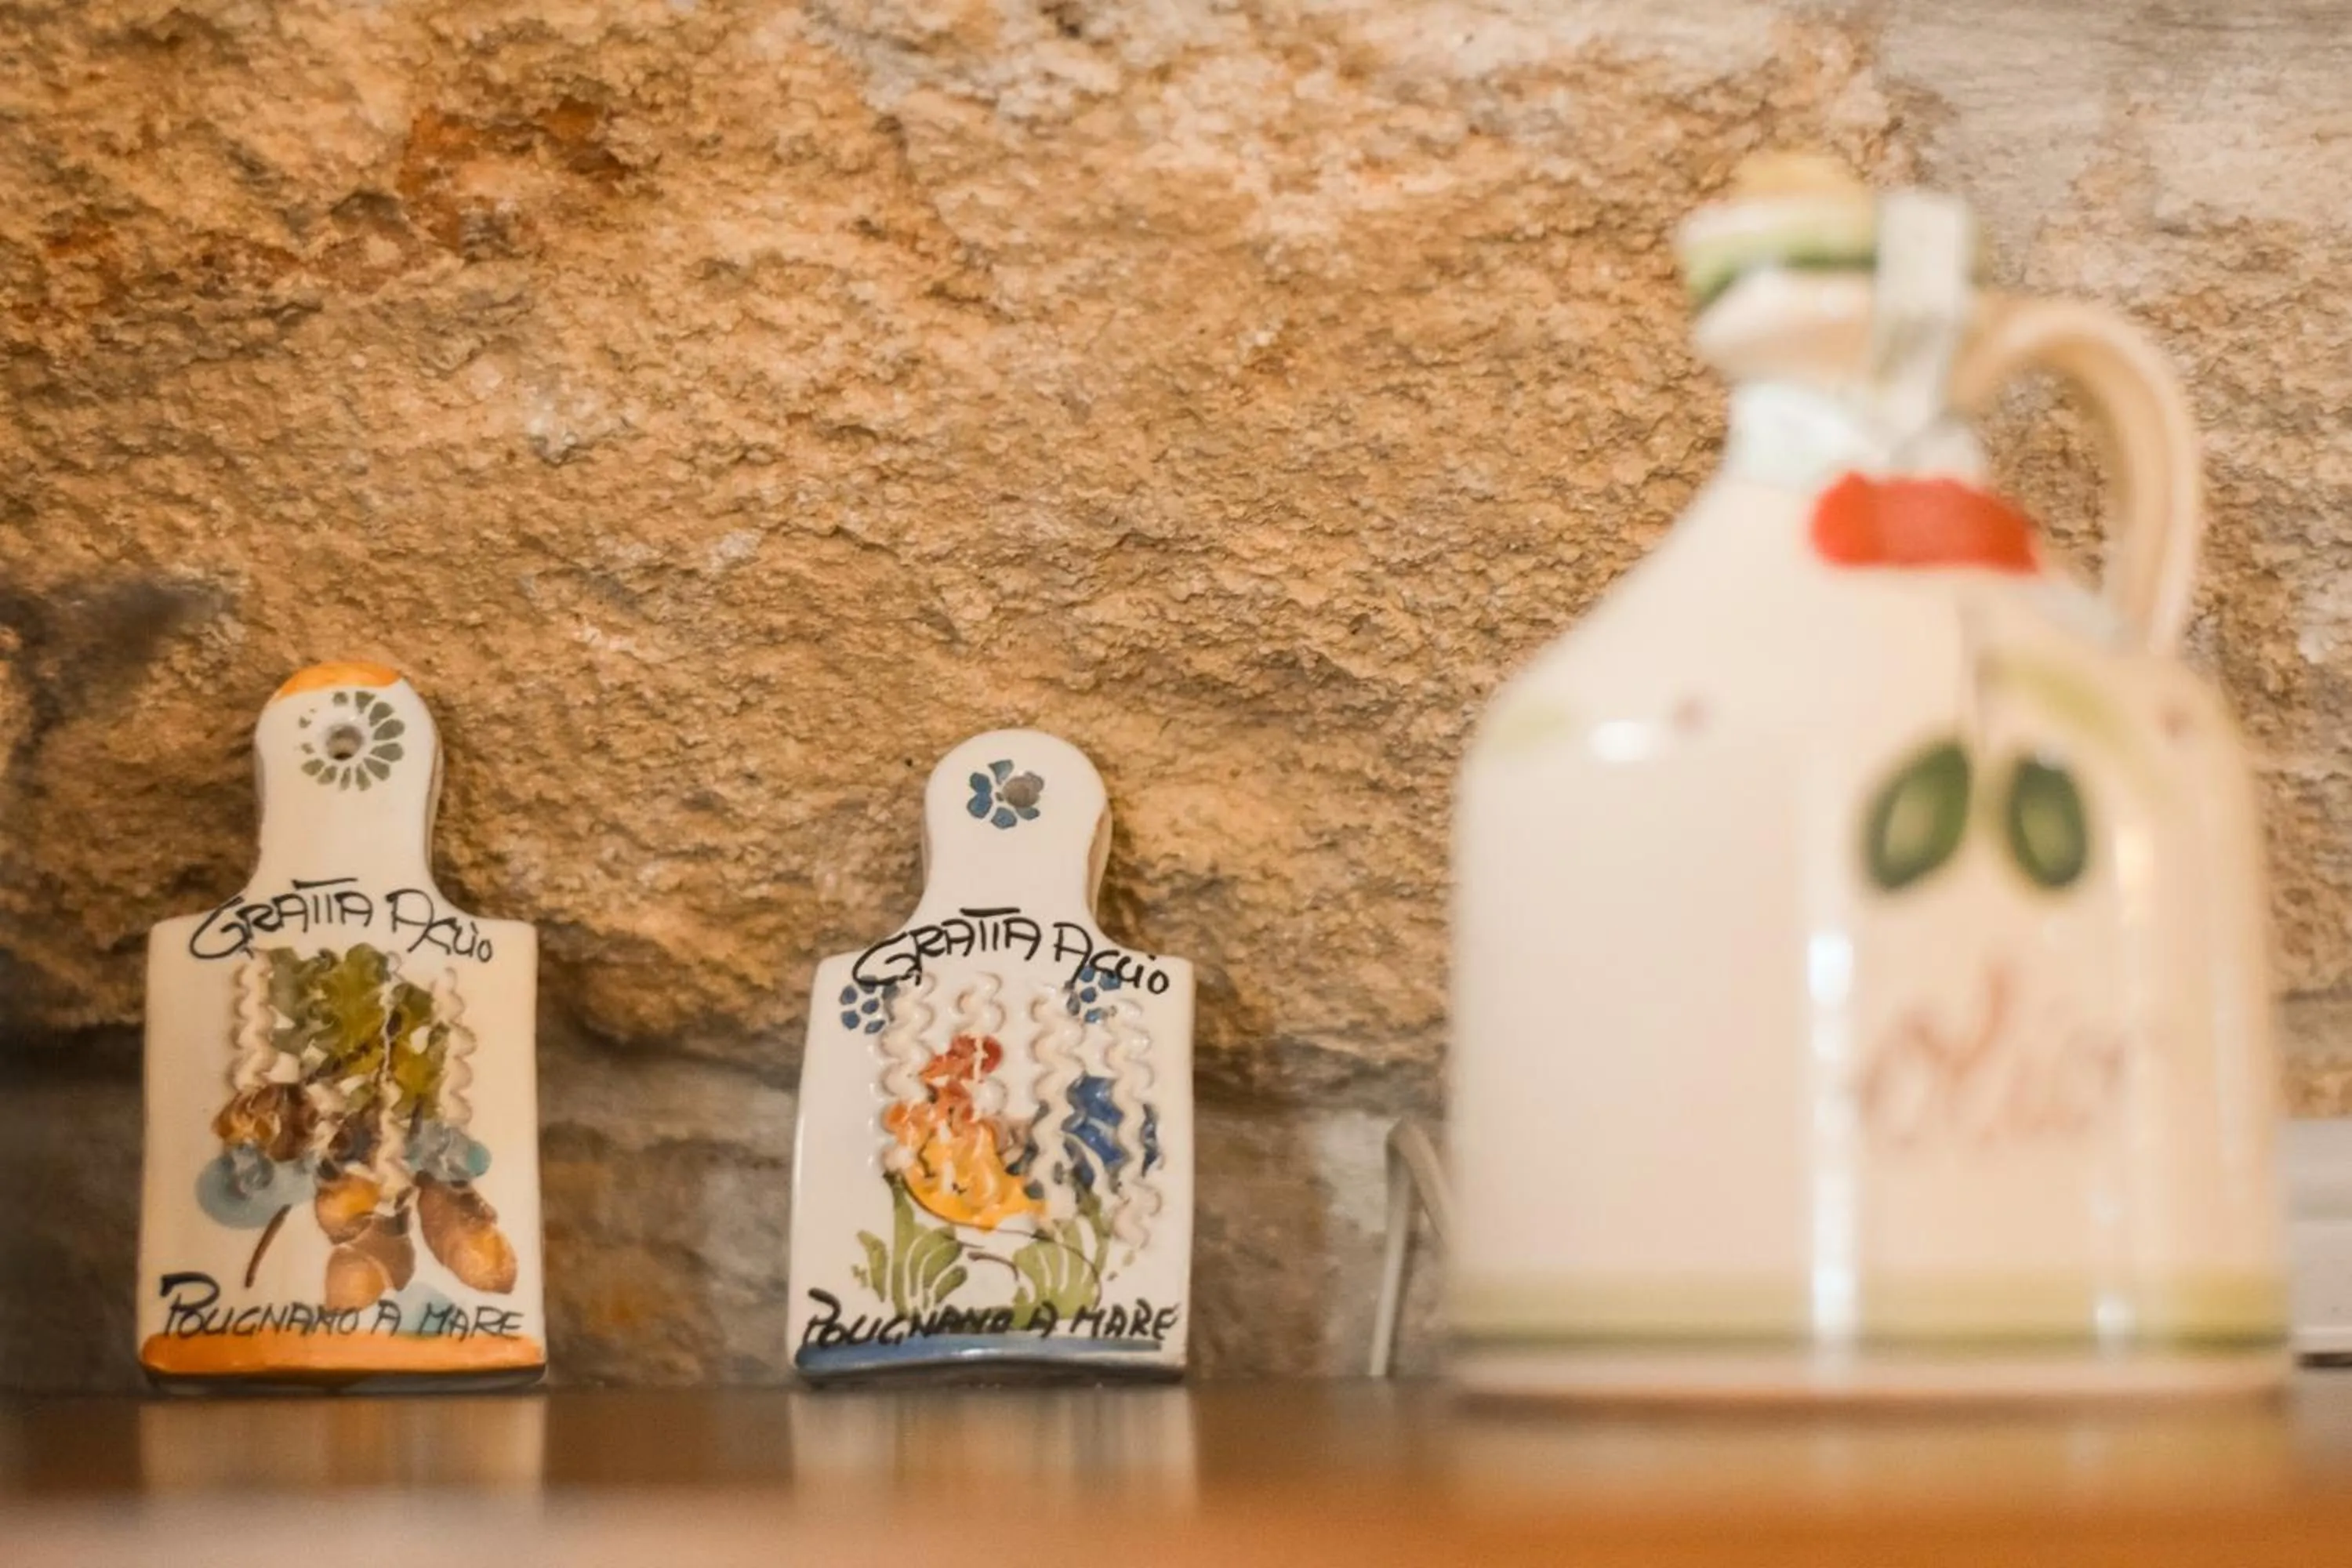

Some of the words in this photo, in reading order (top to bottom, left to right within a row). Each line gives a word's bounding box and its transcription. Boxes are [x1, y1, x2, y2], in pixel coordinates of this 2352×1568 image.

[189, 878, 372, 960] GRATTA
[852, 907, 1042, 986] GRATTA
[376, 1300, 401, 1338] A
[417, 1302, 525, 1341] MARE
[1027, 1300, 1059, 1338] A
[1069, 1298, 1180, 1341] MARE
